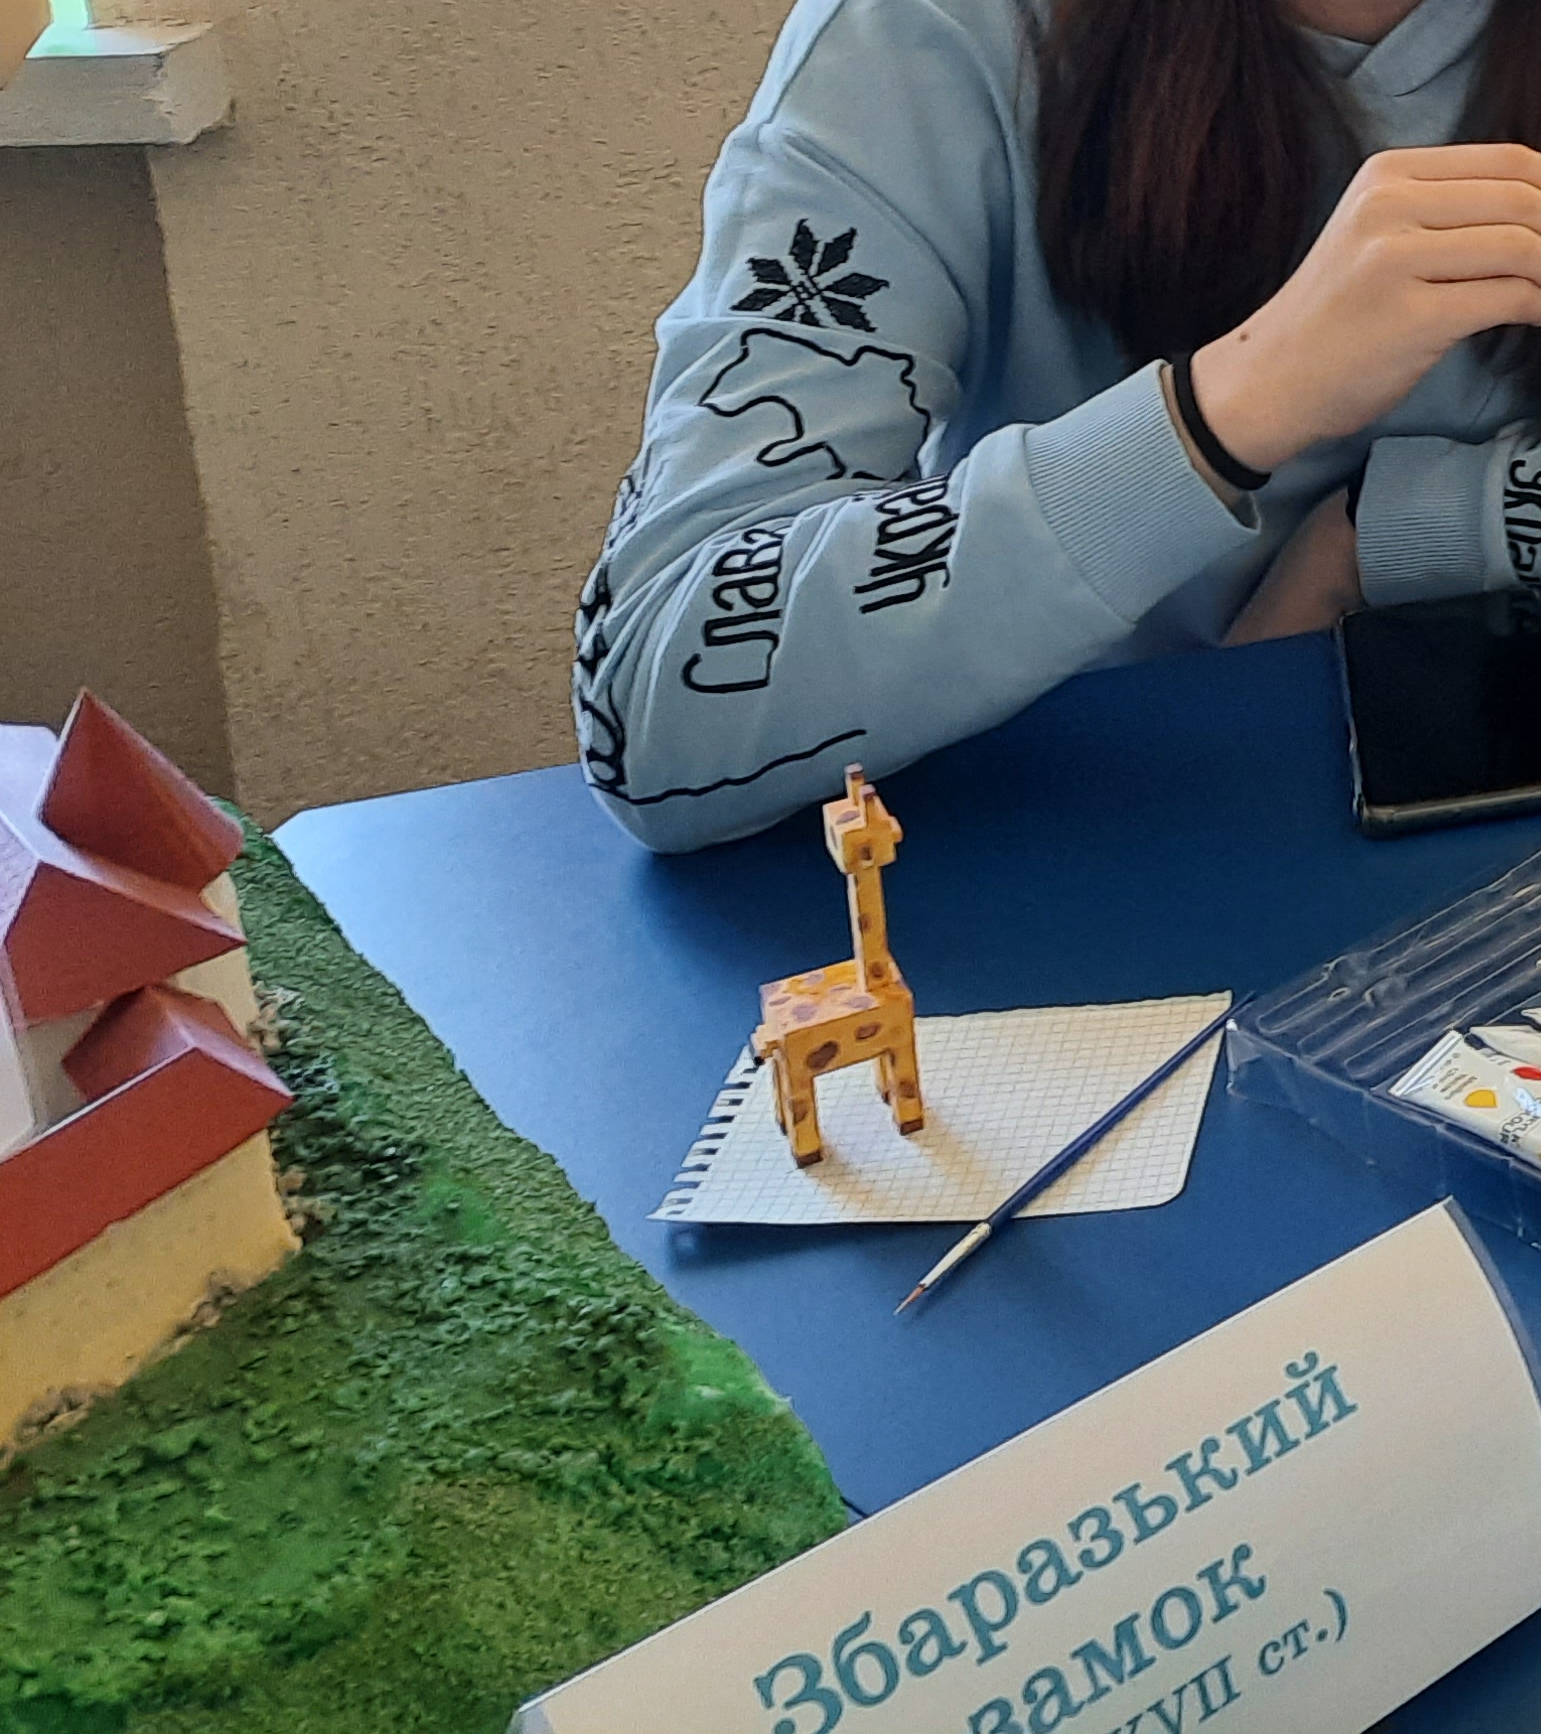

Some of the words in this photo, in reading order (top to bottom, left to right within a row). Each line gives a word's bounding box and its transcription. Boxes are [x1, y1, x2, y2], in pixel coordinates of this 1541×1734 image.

[753, 1351, 1358, 1734] Збаразький
[1108, 1655, 1241, 1734] VII
[1258, 1588, 1348, 1677] ст.)
